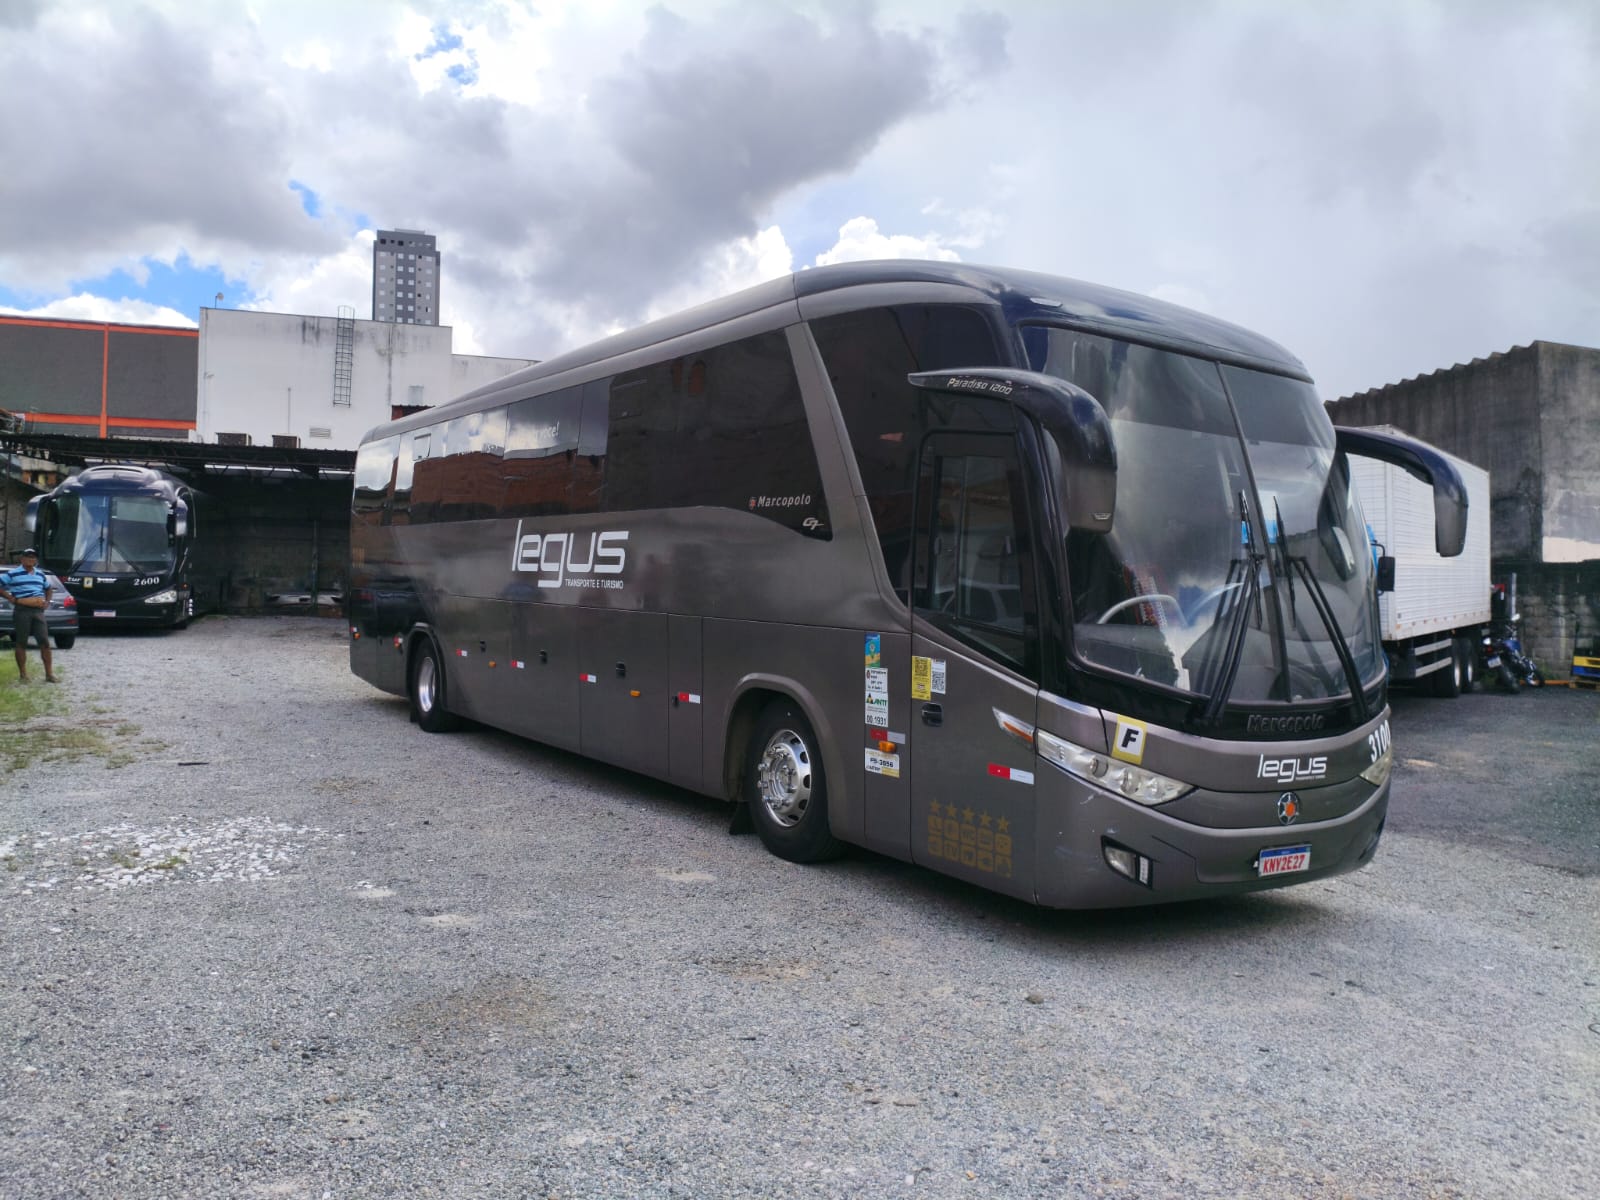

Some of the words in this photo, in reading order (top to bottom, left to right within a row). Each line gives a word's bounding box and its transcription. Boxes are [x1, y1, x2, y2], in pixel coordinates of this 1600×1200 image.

[946, 377, 988, 390] Paradiso
[989, 383, 1013, 395] 1200
[757, 493, 811, 508] Marcopolo
[133, 577, 160, 586] 2600
[565, 578, 595, 588] TRANSPORTE
[601, 579, 624, 589] TURISMO
[1246, 713, 1325, 733] Marcopolo
[1121, 728, 1140, 748] F
[1368, 719, 1391, 763] 3100
[1263, 854, 1306, 873] KNY2E27
